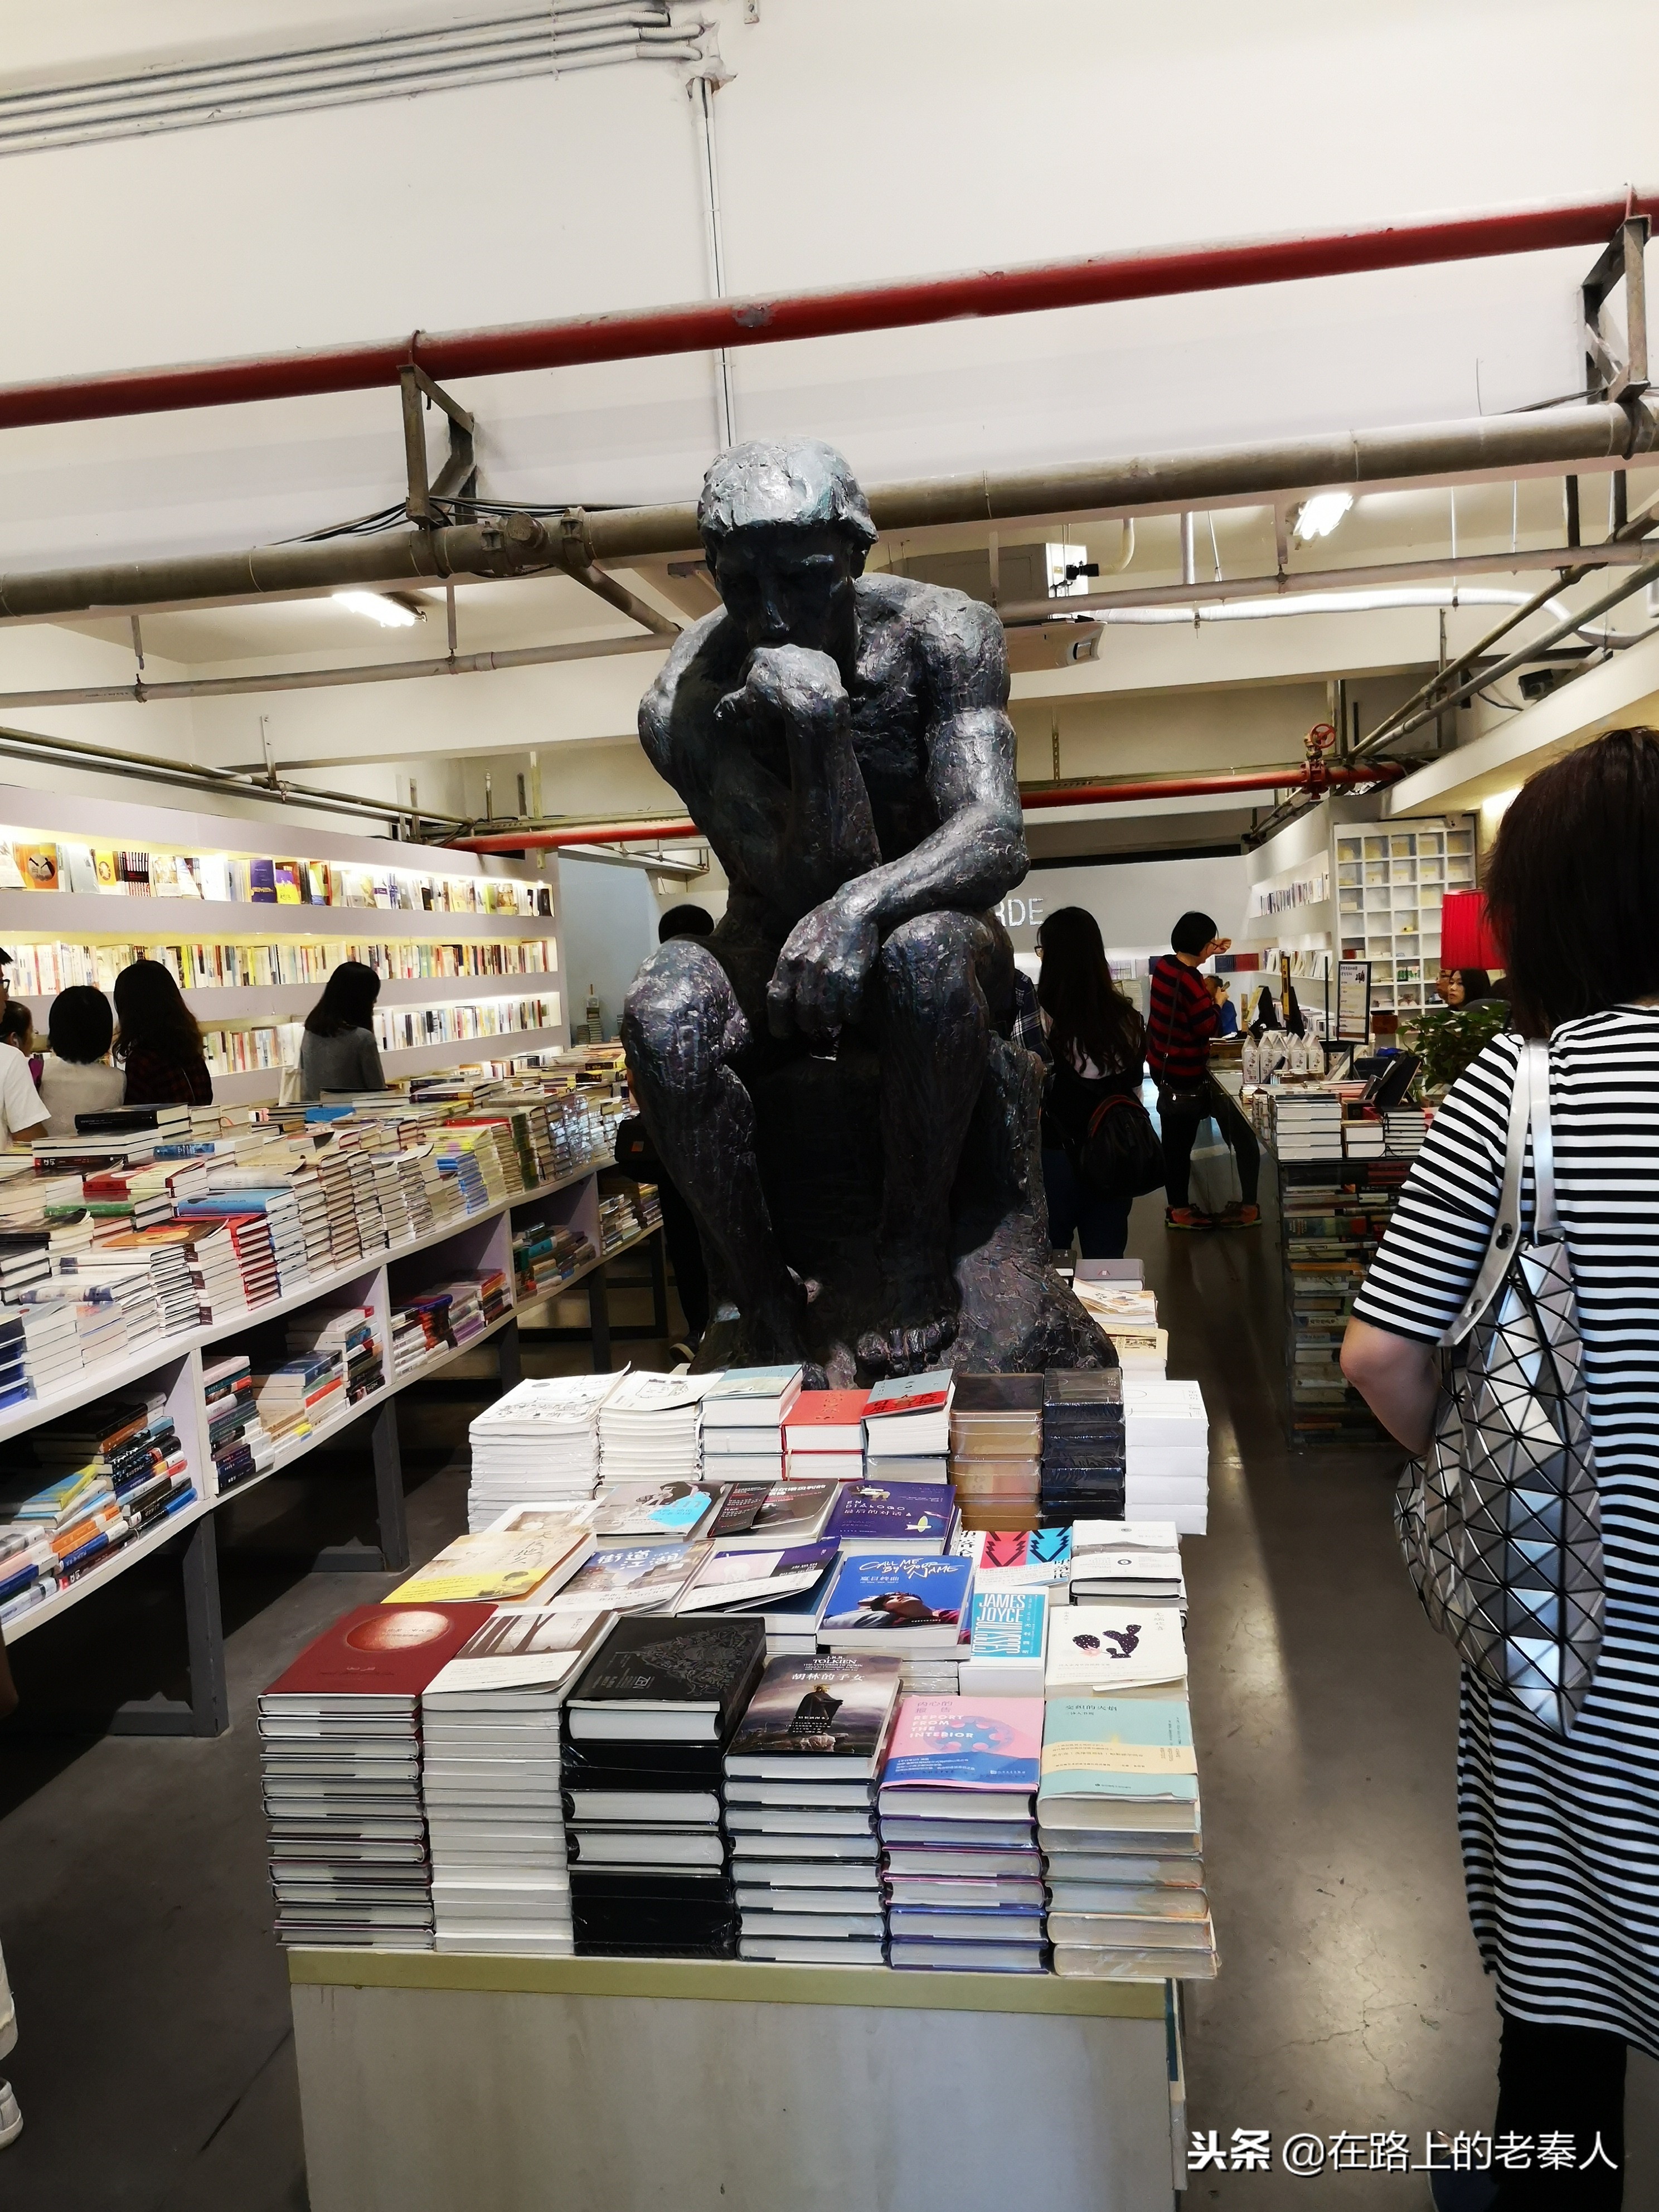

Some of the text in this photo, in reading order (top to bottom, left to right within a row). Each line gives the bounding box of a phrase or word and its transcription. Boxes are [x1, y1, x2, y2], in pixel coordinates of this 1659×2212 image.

[598, 1550, 651, 1564] 街道
[619, 1553, 679, 1570] 江湖
[979, 1594, 1026, 1608] JAMES
[977, 1607, 1025, 1623] JOYCE
[792, 1673, 865, 1681] 胡林的子女
